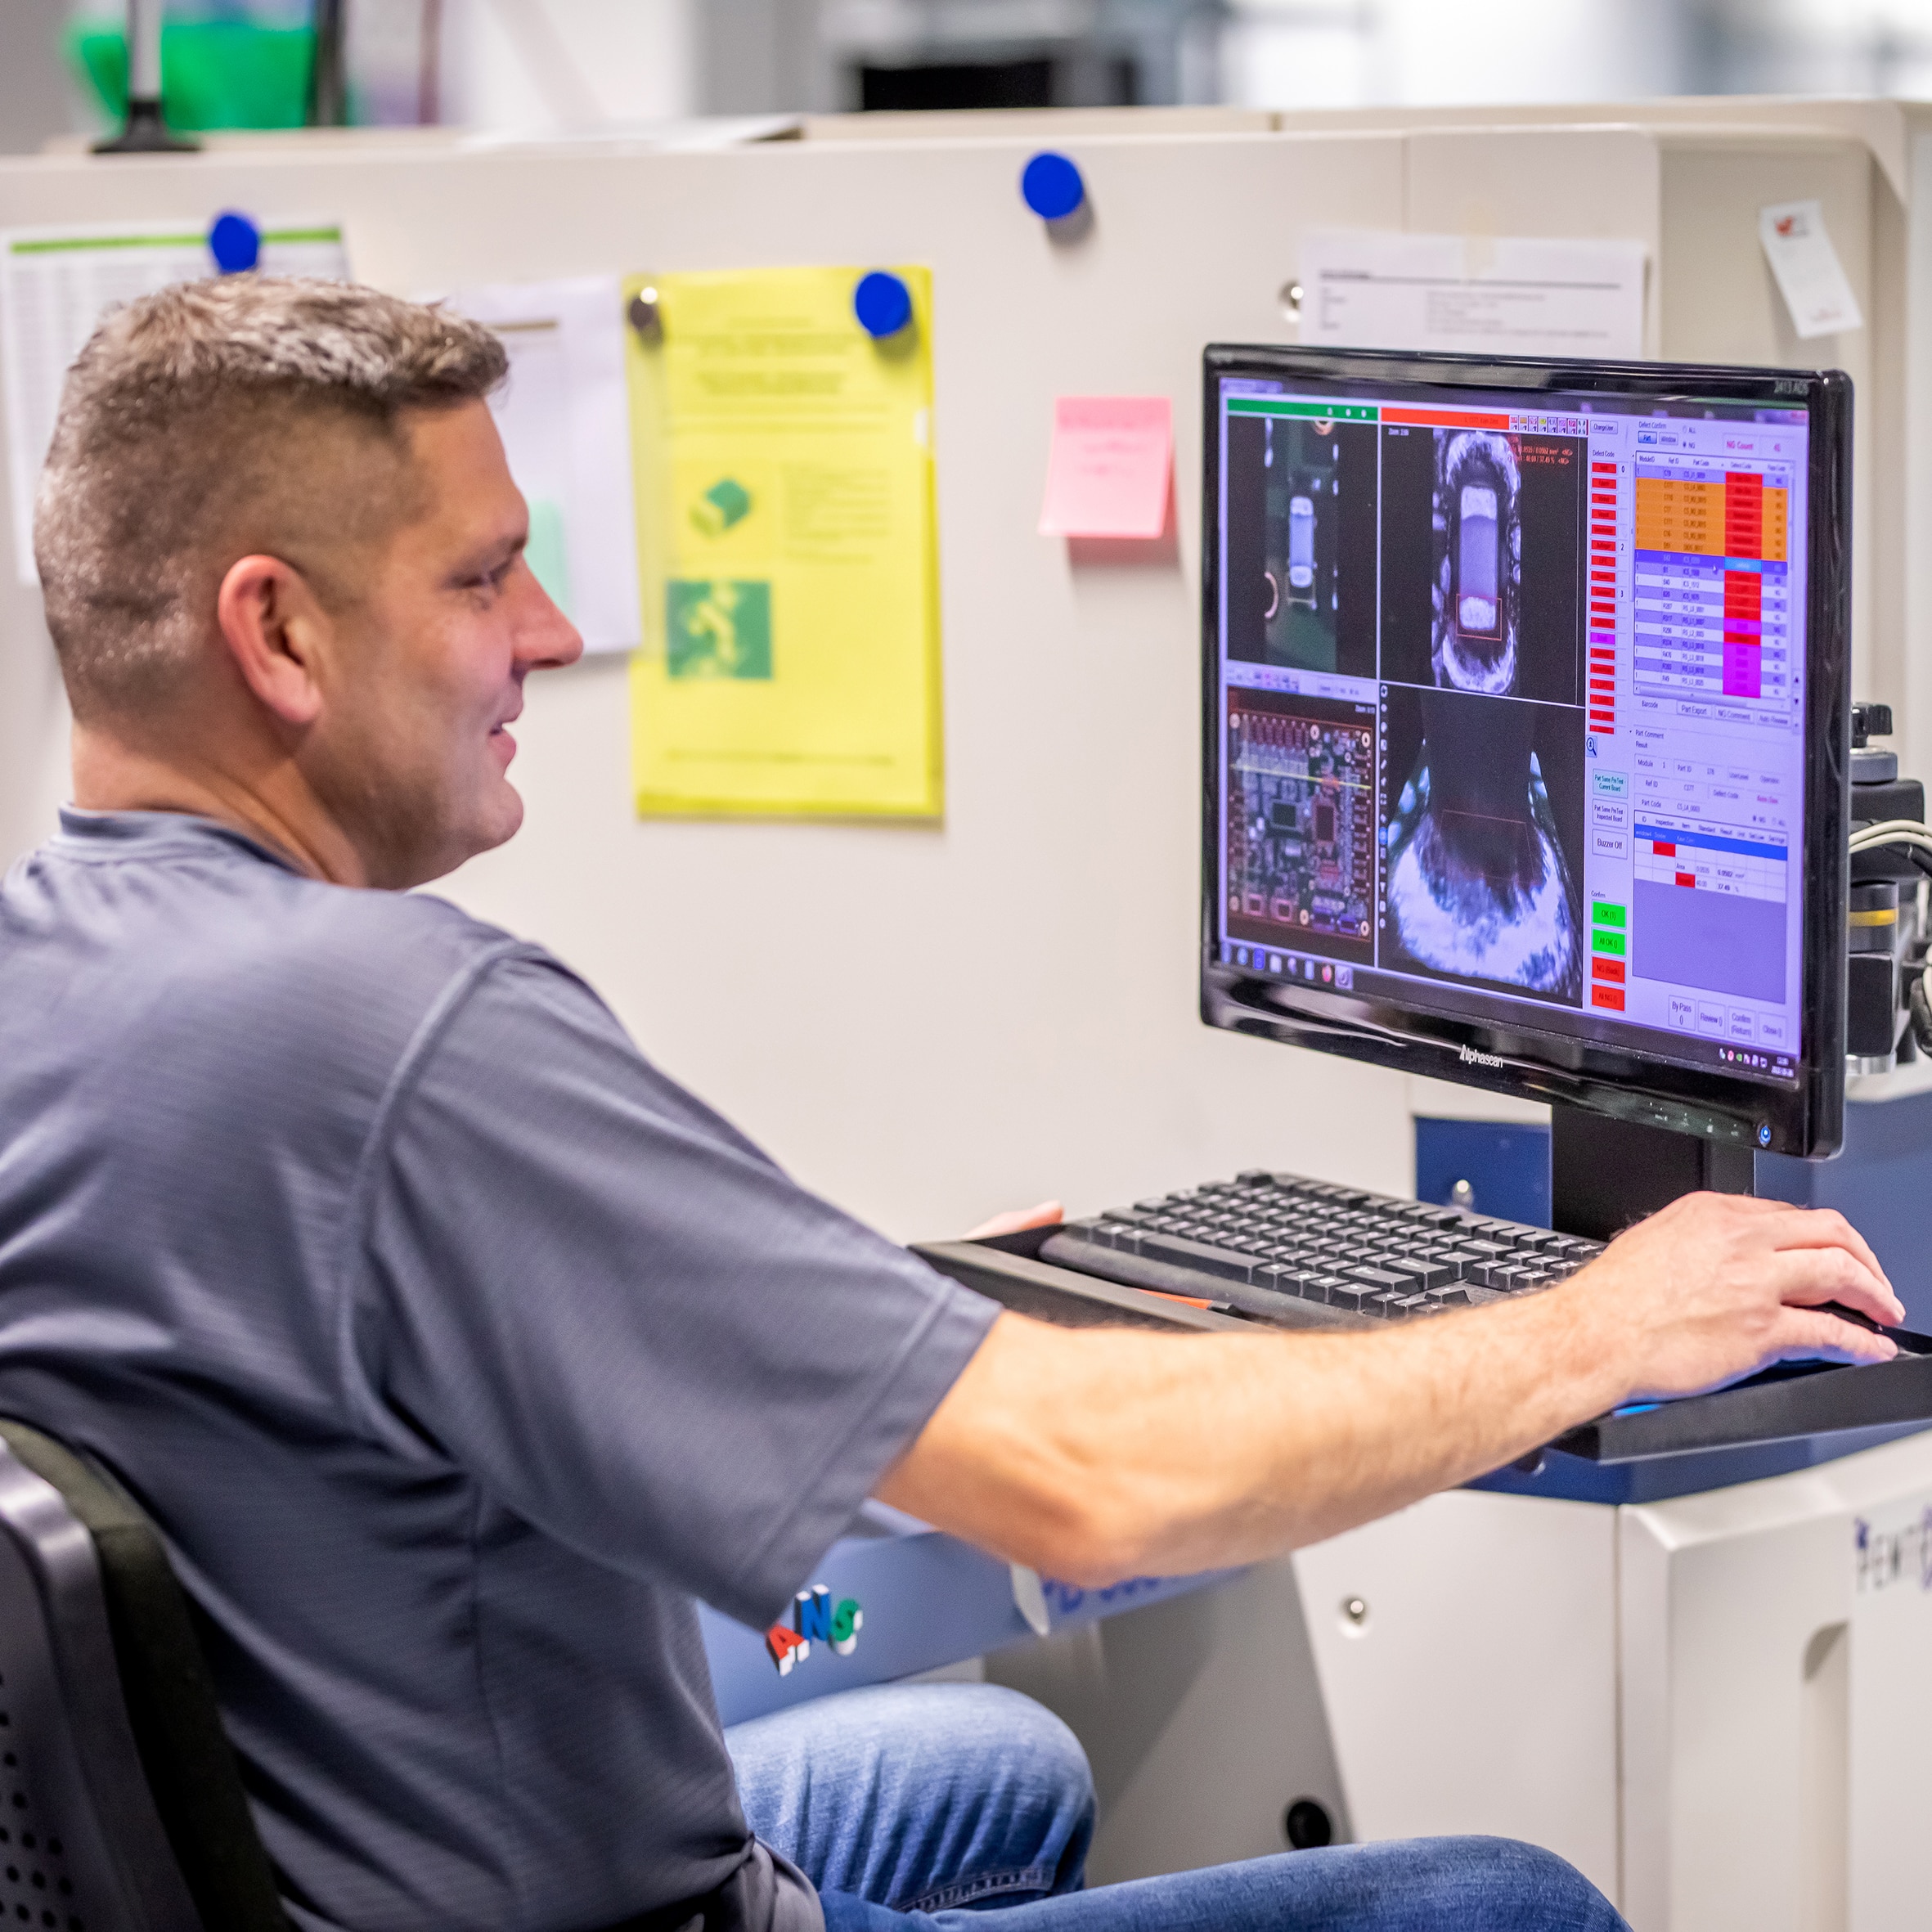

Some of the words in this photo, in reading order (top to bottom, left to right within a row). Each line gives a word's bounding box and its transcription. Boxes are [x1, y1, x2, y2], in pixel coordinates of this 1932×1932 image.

[1621, 590, 1624, 598] 3
[1692, 706, 1707, 714] Export
[1644, 730, 1664, 739] Comment
[1638, 759, 1653, 767] Module
[1651, 800, 1661, 808] Code
[1597, 838, 1613, 847] Buzzer
[1602, 910, 1609, 919] OK
[1606, 938, 1613, 946] OK
[1672, 1001, 1678, 1012] By
[1679, 1003, 1692, 1013] Pass
[1701, 1013, 1718, 1023] Review
[1732, 1013, 1750, 1023] Confirm
